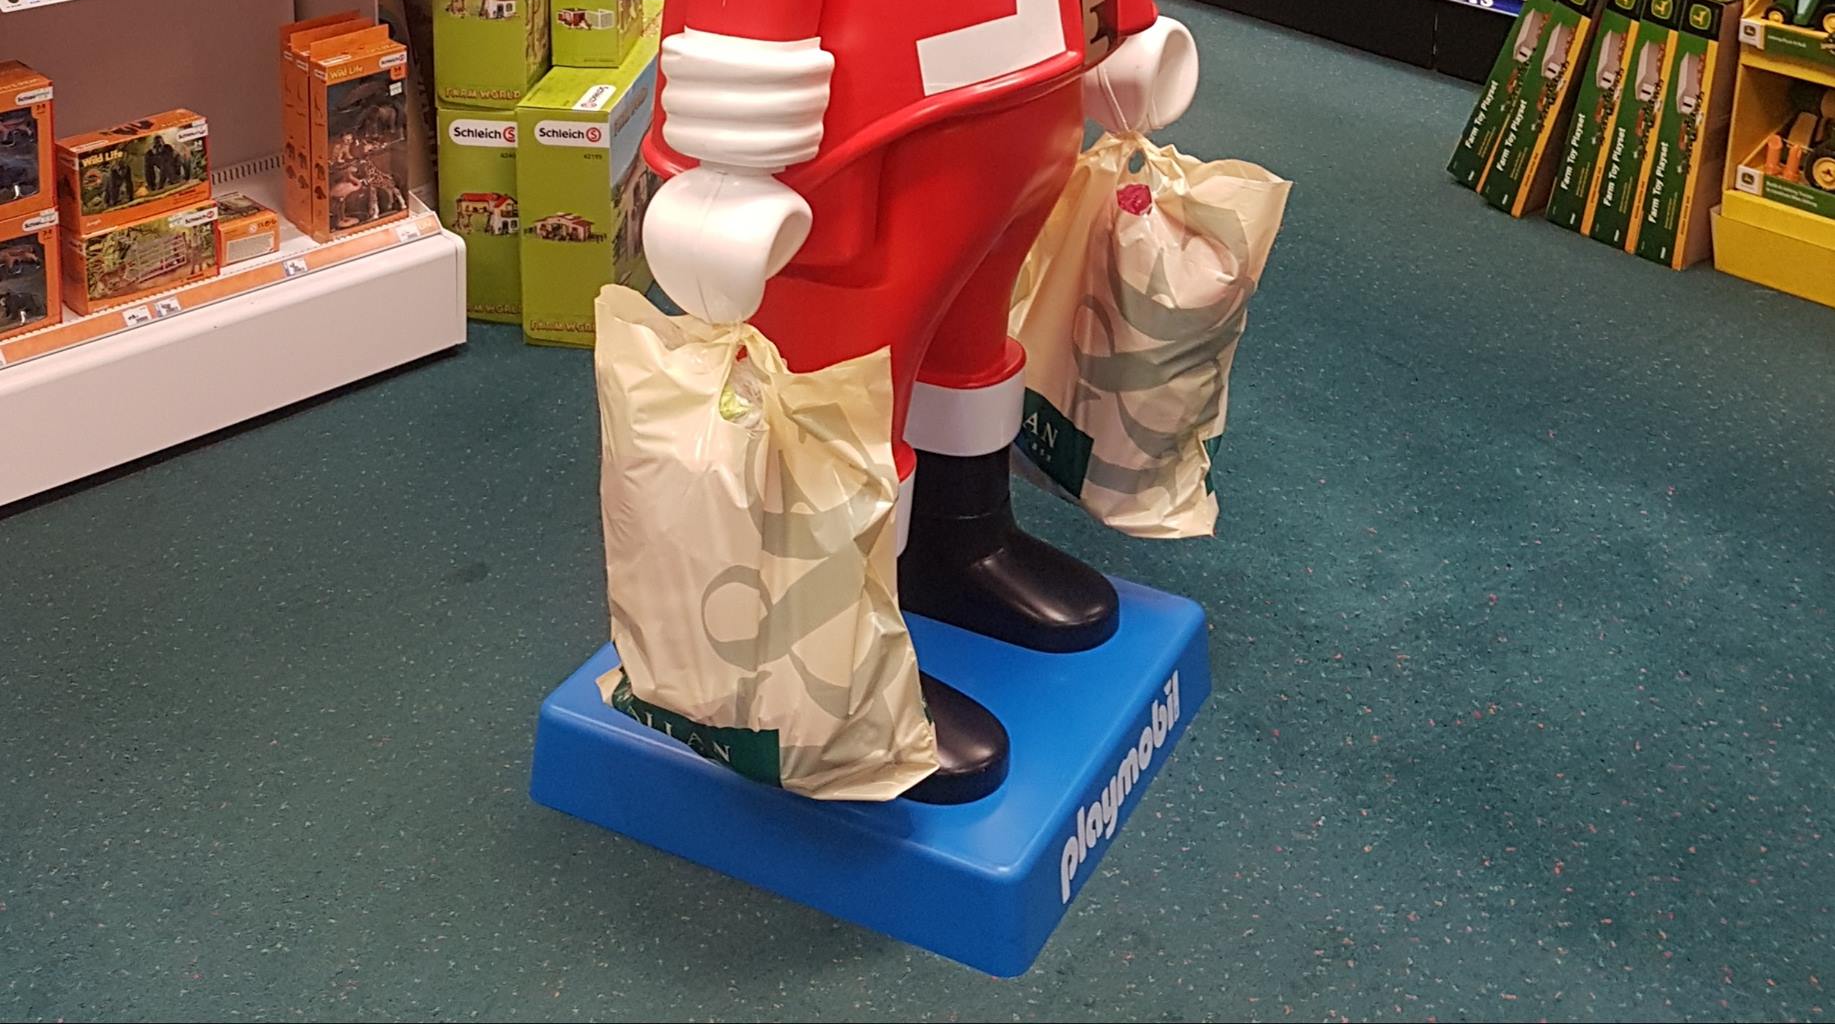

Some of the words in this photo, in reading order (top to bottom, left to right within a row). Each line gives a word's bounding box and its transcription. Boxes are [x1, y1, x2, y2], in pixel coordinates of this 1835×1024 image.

[1465, 127, 1479, 149] Farm
[1474, 111, 1487, 126] Toy
[1481, 80, 1499, 111] Playset
[1510, 99, 1528, 132] Playset
[453, 126, 502, 141] Schleich
[539, 127, 585, 141] Schleich
[1505, 132, 1517, 147] Toy
[1571, 112, 1586, 149] Playset
[1566, 149, 1579, 165] Toy
[1612, 127, 1626, 163] Playset
[82, 154, 104, 168] Wild
[105, 150, 123, 162] Life
[1496, 148, 1511, 172] Farm
[1655, 141, 1669, 178] Playset
[1560, 166, 1573, 190] Farm
[1608, 164, 1621, 182] Toy
[1603, 182, 1617, 207] Farm
[1652, 181, 1665, 199] Toy
[1648, 199, 1661, 224] Farm
[1060, 669, 1181, 905] playmobil
